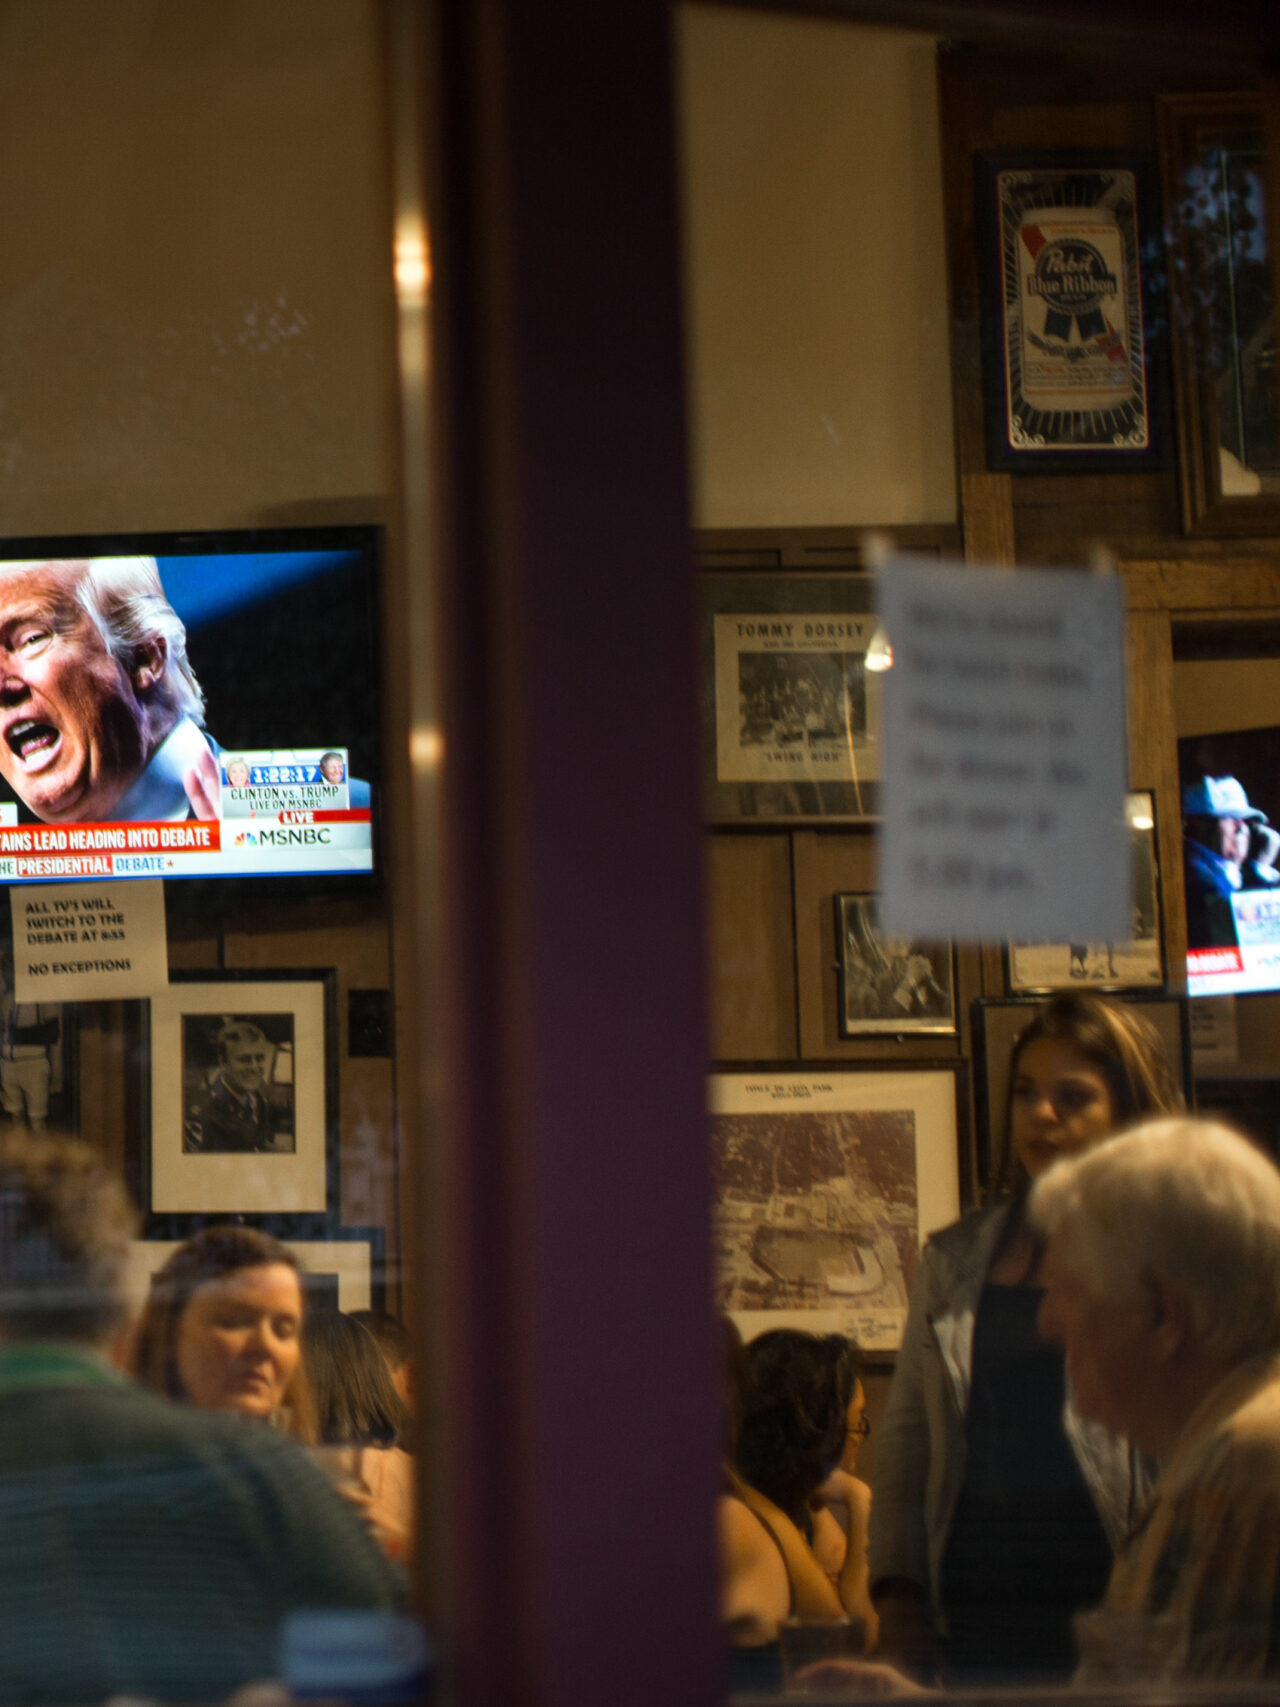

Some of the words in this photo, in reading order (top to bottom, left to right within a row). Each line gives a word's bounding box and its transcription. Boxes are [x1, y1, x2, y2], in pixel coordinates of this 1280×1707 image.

[1029, 276, 1060, 294] Blue
[1063, 273, 1116, 297] Ribbon
[736, 623, 793, 638] TOMMY
[804, 623, 864, 638] DORSEY
[253, 767, 316, 783] 1:22:17
[231, 788, 279, 800] CLINTON
[282, 790, 298, 799] vs.
[301, 786, 339, 799] TRUMP
[249, 802, 270, 810] LIVE
[274, 801, 285, 809] ON
[288, 799, 322, 809] MSNBC
[282, 812, 314, 824] LIVE
[33, 831, 67, 851] LEAD
[69, 829, 125, 850] HEADING
[128, 828, 158, 848] INTO
[160, 826, 210, 847] DEBATE
[259, 828, 332, 846] MSNBC
[18, 857, 112, 874] PRESIDENTIAL
[115, 857, 165, 872] DEBATE
[26, 901, 50, 914] ALL
[81, 897, 115, 910] WILL
[26, 915, 75, 929] SWITCH
[78, 914, 96, 926] TO
[99, 913, 124, 925] THE
[27, 930, 78, 945] DEBATE
[81, 929, 98, 942] AT
[28, 963, 48, 976] NO
[52, 958, 132, 974] EXCEPTIONS
